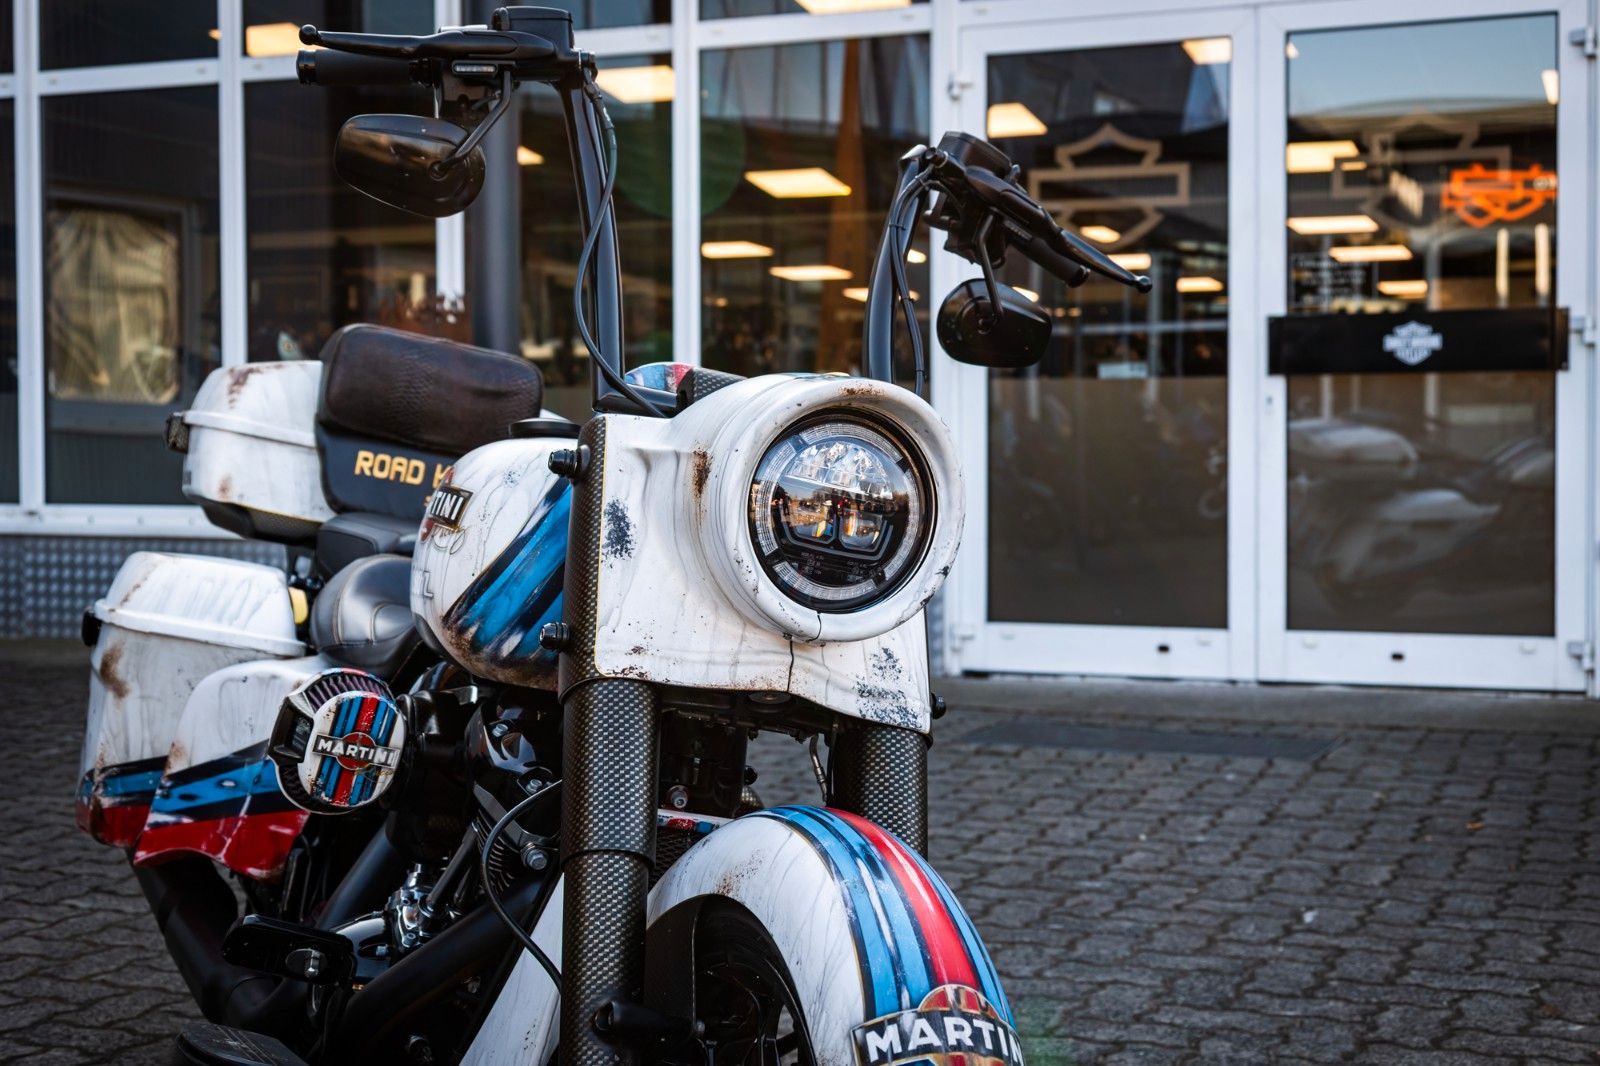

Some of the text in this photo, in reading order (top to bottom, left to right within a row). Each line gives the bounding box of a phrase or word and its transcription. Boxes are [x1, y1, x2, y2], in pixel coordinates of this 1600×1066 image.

[354, 450, 426, 486] ROAD
[430, 490, 464, 521] TINI
[317, 738, 395, 766] MARTINI
[865, 1016, 1025, 1066] MARTIN
